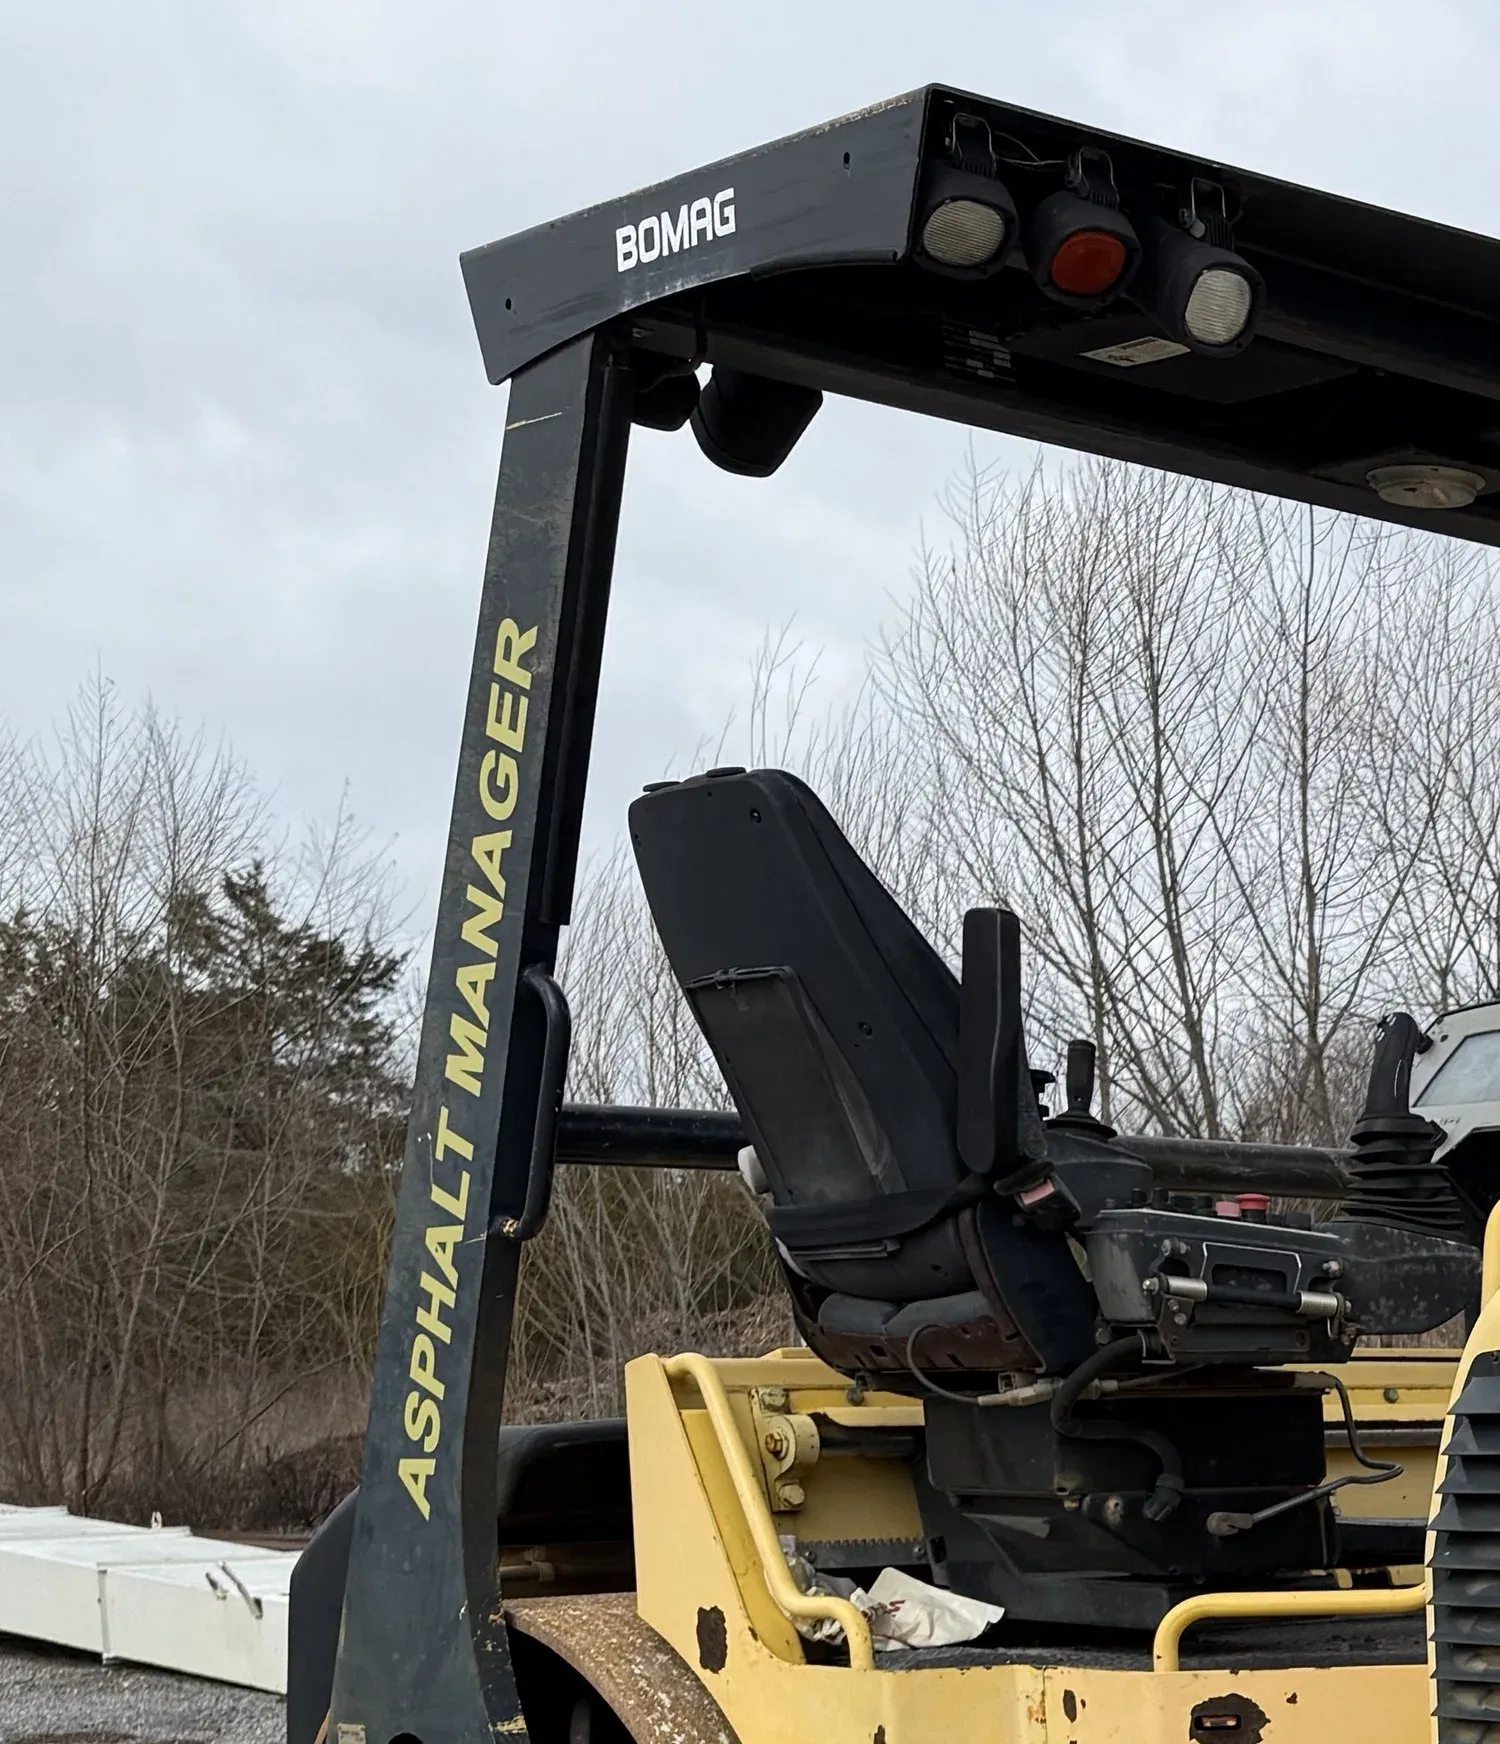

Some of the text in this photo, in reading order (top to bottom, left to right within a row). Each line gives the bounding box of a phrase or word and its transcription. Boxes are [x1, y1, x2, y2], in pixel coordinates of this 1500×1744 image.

[616, 187, 736, 273] BOMAG
[399, 618, 539, 1522] ASPHALT MANAGER
